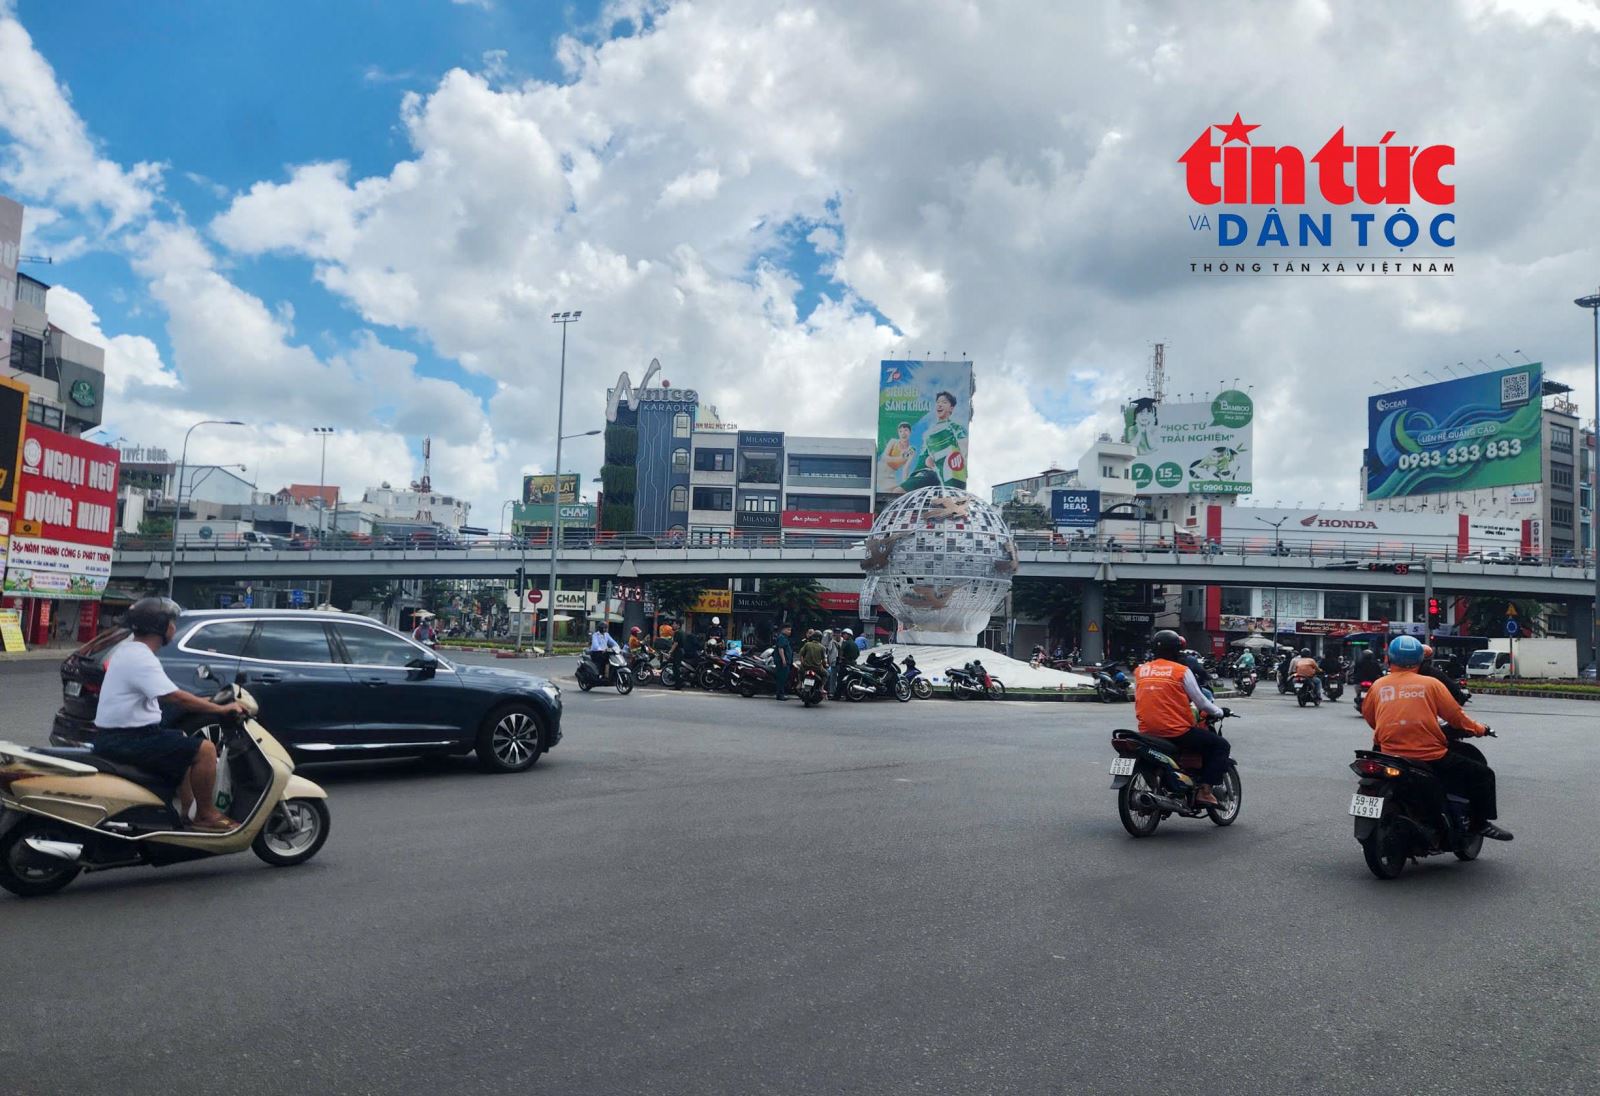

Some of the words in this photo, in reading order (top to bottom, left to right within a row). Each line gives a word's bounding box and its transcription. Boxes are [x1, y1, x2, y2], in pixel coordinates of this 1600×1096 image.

[643, 380, 698, 402] nice
[643, 404, 696, 412] KARAOKE
[745, 436, 779, 445] MILANDO
[1399, 450, 1441, 470] 0933
[1446, 444, 1480, 464] 333
[1486, 438, 1522, 459] 833
[42, 447, 86, 490] NGOẠI
[88, 460, 117, 493] NGỮ
[1135, 468, 1145, 479] 7
[1158, 468, 1173, 478] 15
[23, 490, 72, 528] DƯƠNG
[76, 501, 111, 534] MINH
[1318, 519, 1379, 529] HONDA
[708, 597, 730, 611] CẬN
[1151, 669, 1172, 677] Food
[1399, 690, 1425, 699] Food
